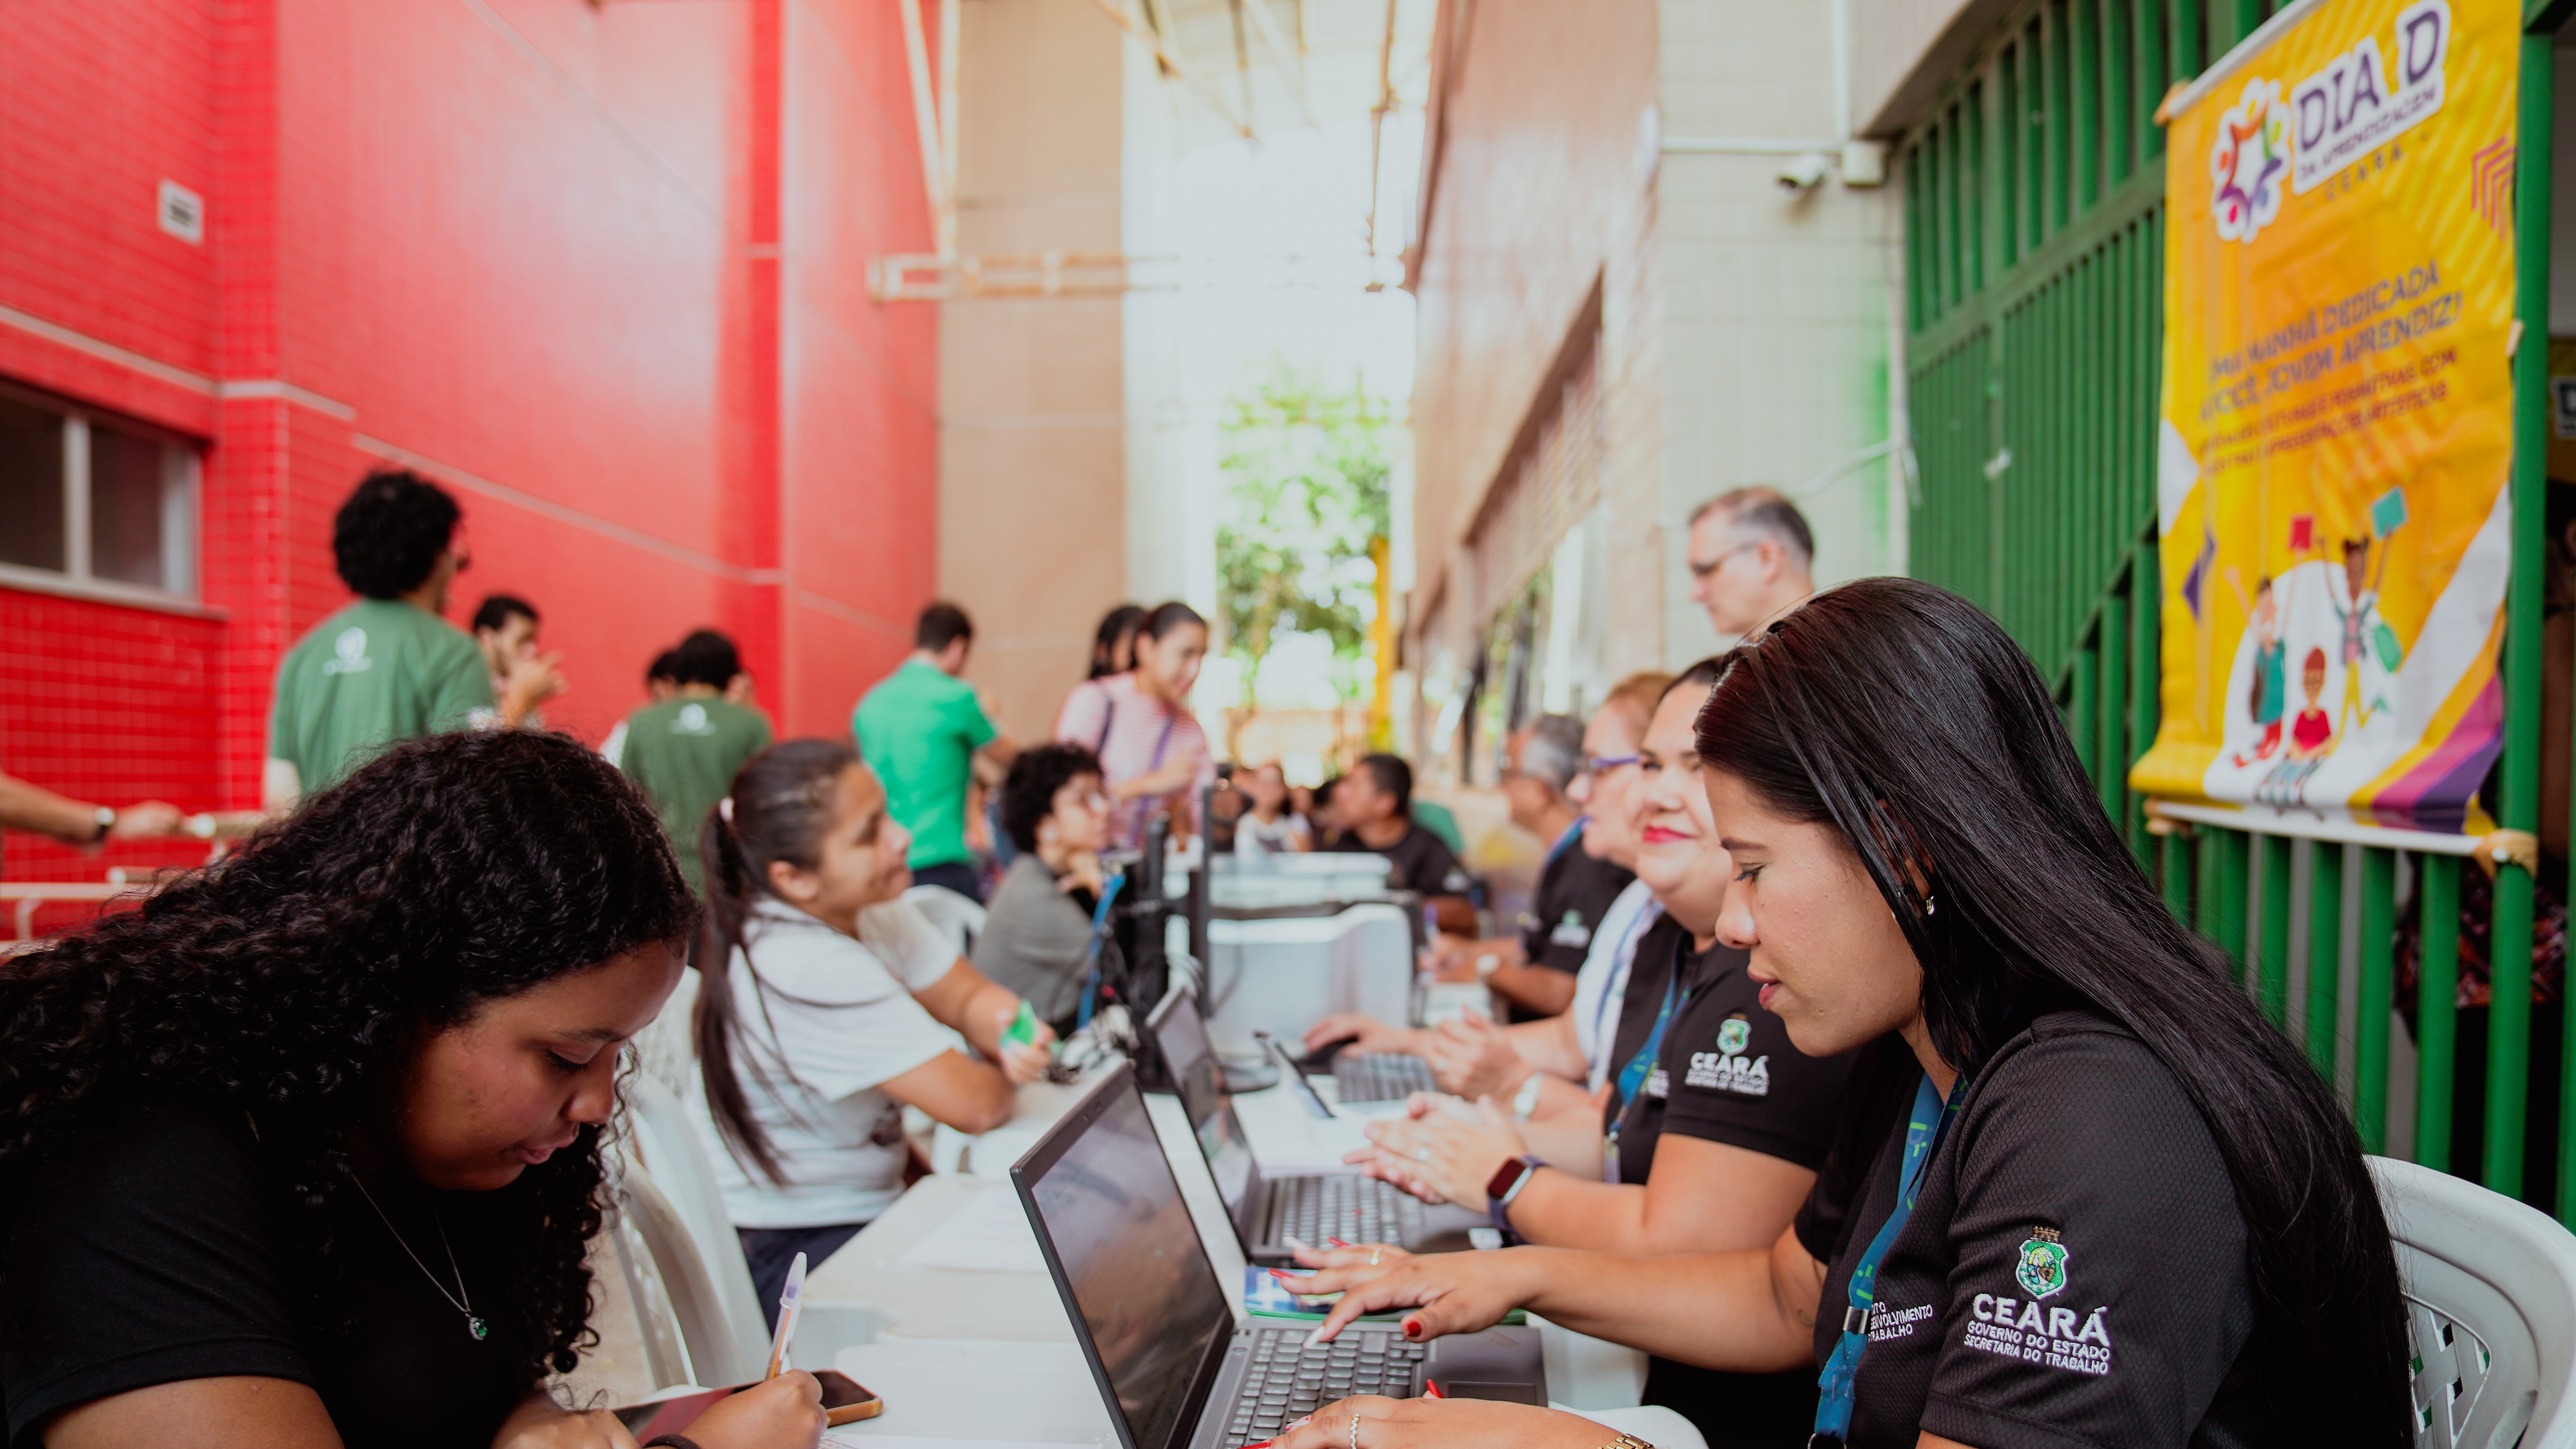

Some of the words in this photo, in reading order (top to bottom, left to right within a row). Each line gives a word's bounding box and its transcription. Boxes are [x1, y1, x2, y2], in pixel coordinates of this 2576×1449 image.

[2299, 52, 2379, 152] DIA
[2406, 10, 2440, 84] D
[2323, 258, 2440, 335] DEDICADA
[2263, 345, 2334, 395] JOVEM
[2339, 289, 2464, 364] APRENDIZ!
[2419, 346, 2457, 377] COM
[1691, 1051, 1769, 1078] CEARÁ
[1967, 1320, 2023, 1344] GOVERNO
[2026, 1334, 2048, 1350] DO
[2052, 1339, 2110, 1362] ESTADO
[1972, 1293, 2110, 1347] CEARÁ
[1964, 1334, 2020, 1358] SECRETARIA
[2023, 1347, 2041, 1362] DO
[2045, 1352, 2108, 1375] TRABALHO
